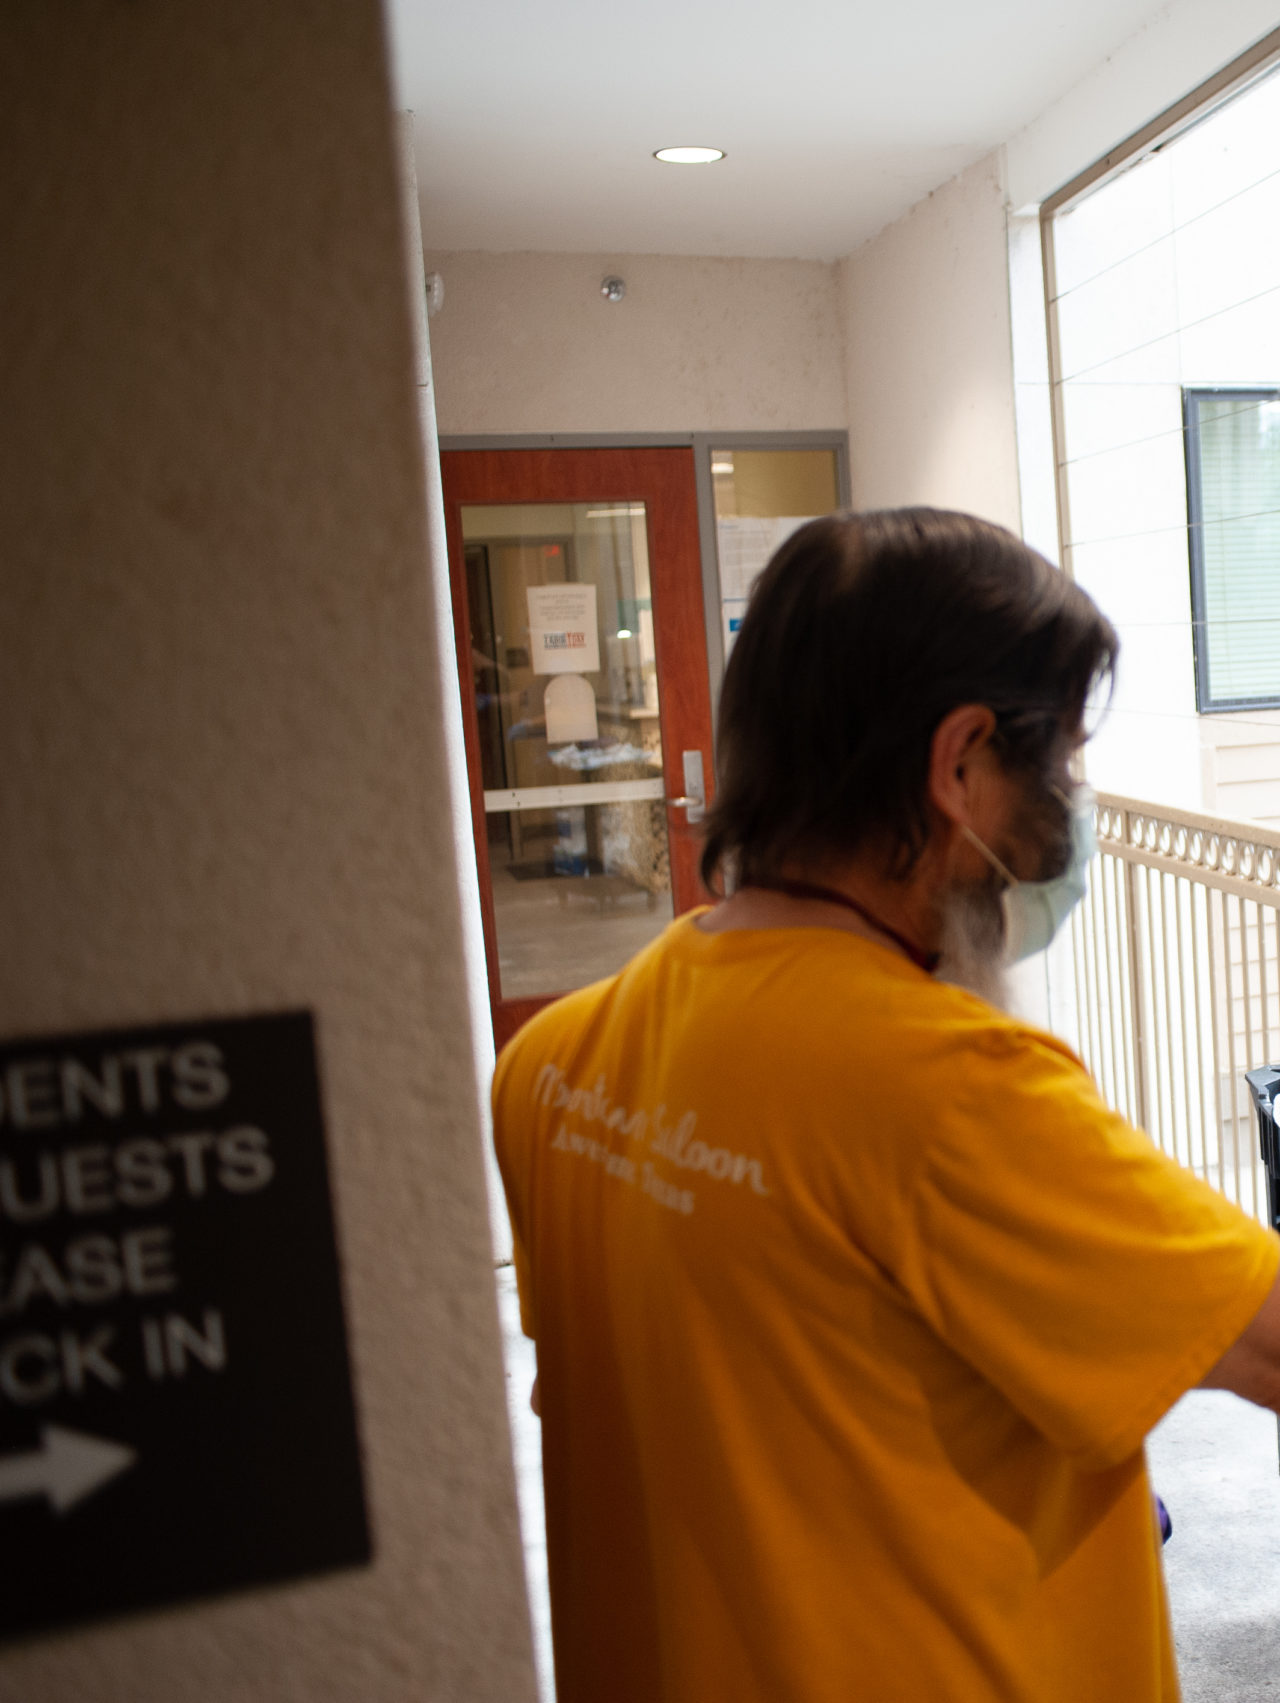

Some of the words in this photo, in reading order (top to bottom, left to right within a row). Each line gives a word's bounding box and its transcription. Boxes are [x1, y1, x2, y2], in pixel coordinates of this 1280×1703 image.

[0, 1040, 230, 1131] ENTS
[0, 1123, 275, 1223] UESTS
[0, 1225, 179, 1315] ASE
[0, 1322, 124, 1406] CK
[141, 1306, 229, 1381] IN
